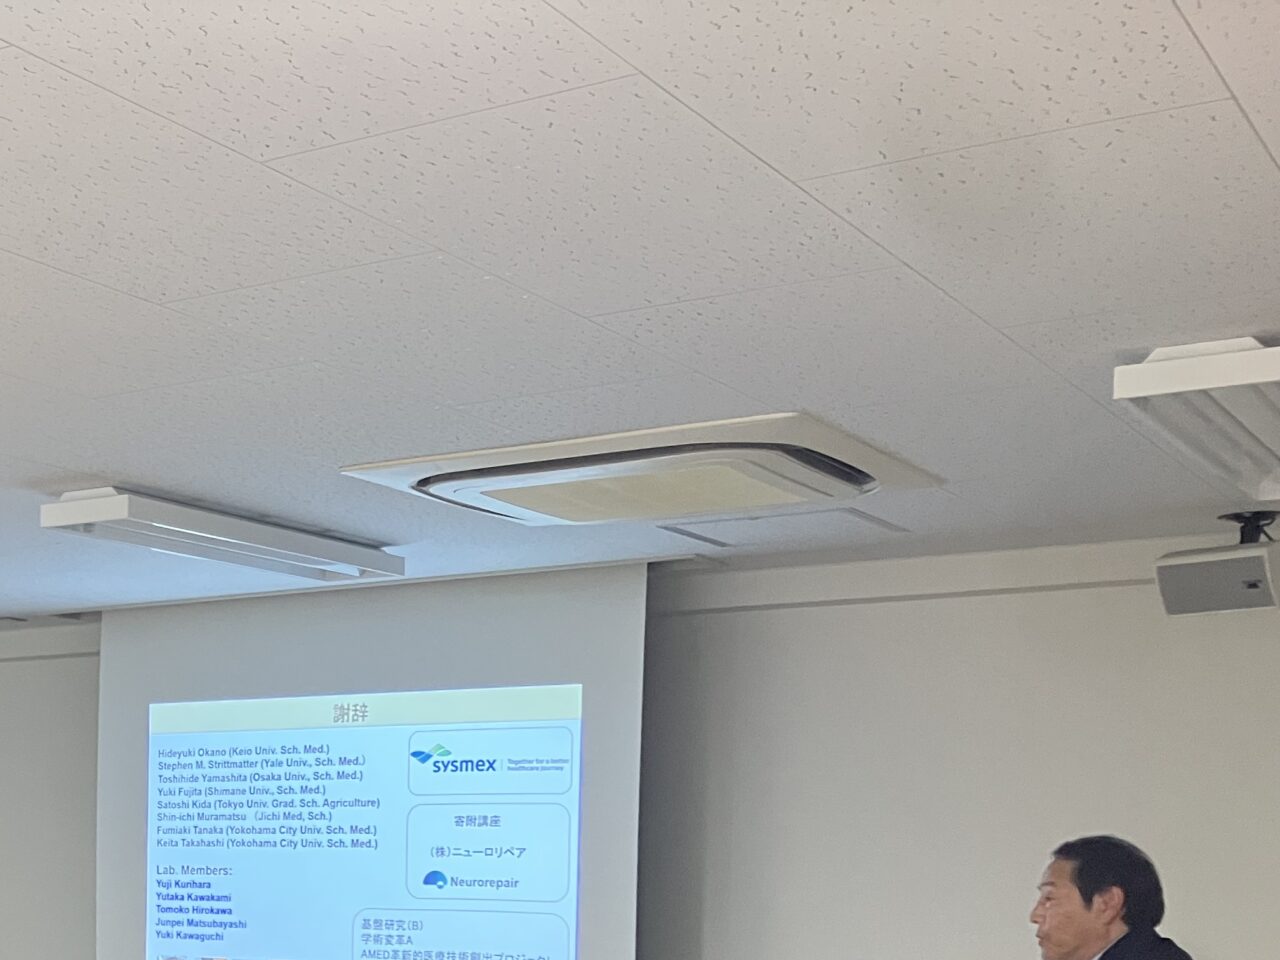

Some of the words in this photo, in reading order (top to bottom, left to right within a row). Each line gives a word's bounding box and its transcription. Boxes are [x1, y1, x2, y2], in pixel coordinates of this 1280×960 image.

[333, 702, 369, 723] 謝辞
[158, 749, 196, 759] Hideyuki
[198, 748, 226, 757] Okano
[228, 747, 252, 758] (Keio
[255, 746, 278, 755] Univ.
[280, 745, 301, 754] Sch.
[303, 744, 330, 755] Med.)
[158, 761, 193, 771] Stephen
[195, 760, 206, 769] M.
[208, 760, 258, 769] Strittmatter
[260, 759, 283, 770] (Yale
[314, 757, 336, 767] Sch.
[432, 758, 497, 773] sysmex
[158, 774, 199, 784] Toshihide
[201, 773, 247, 782] Yamashita
[249, 772, 282, 783] (Osaka
[313, 771, 334, 780] Sch.
[336, 770, 363, 782] Med.)
[157, 788, 176, 796] Yuki
[178, 787, 202, 798] Fujita
[204, 786, 247, 797] (Shimane
[276, 785, 298, 795] Sch.
[300, 784, 326, 796] Med.)
[157, 800, 189, 809] Satoshi
[192, 800, 211, 809] Kida
[214, 799, 244, 810] (Tokyo
[246, 799, 269, 808] Univ.
[272, 799, 297, 808] Grad.
[299, 799, 320, 808] Sch.
[322, 797, 380, 809] Agriculture)
[157, 812, 195, 821] Shin-ichi
[197, 812, 247, 821] Muramatsu
[307, 811, 332, 822] Sch.)
[157, 826, 191, 834] Fumiaki
[193, 826, 223, 834] Tanaka
[225, 825, 276, 836] (Yokohama
[279, 825, 297, 836] City
[300, 825, 324, 835] Univ.
[326, 825, 348, 835] Sch.
[350, 825, 377, 837] Med.)
[157, 838, 178, 847] Keita
[181, 838, 225, 847] Takahashi
[226, 838, 277, 849] (Yokohama
[280, 839, 298, 850] City
[300, 839, 325, 848] Univ.
[327, 839, 348, 848] Sch.
[351, 839, 378, 850] Med.)
[156, 865, 178, 875] Lab.
[181, 865, 233, 876] Members:
[155, 879, 172, 890] Yuji
[450, 876, 520, 890] Neurorepair
[155, 892, 185, 901] Yutaka
[187, 892, 232, 902] Kawakami
[156, 904, 190, 914] Tomoko
[192, 905, 233, 915] Hirokawa
[155, 918, 184, 928] Junpei
[186, 918, 247, 930] Matsubayashi
[155, 930, 174, 939] Yuki
[176, 930, 224, 942] Kawaguchi
